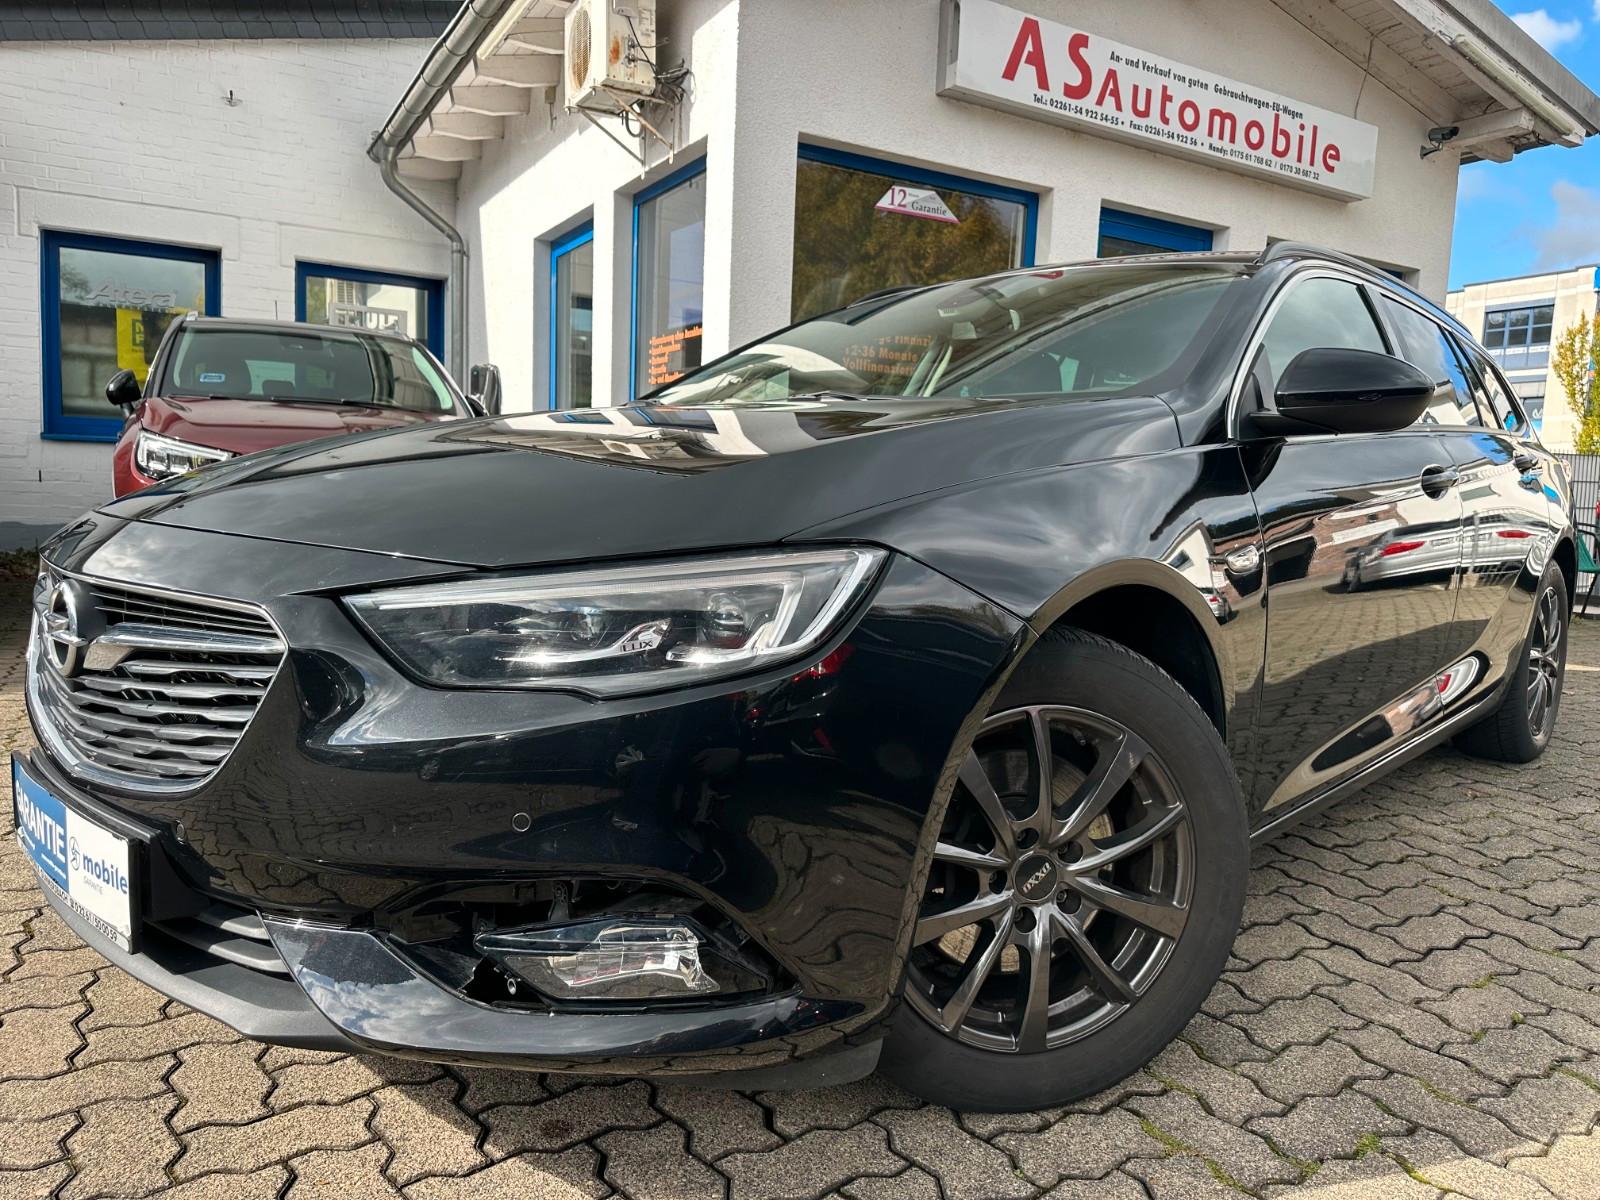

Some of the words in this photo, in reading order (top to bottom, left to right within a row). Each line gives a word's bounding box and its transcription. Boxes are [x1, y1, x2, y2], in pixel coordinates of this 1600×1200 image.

[1109, 50, 1123, 63] An-
[1125, 57, 1140, 69] und
[1142, 60, 1172, 79] Verkauf
[1173, 72, 1187, 84] von
[1187, 78, 1209, 91] guten
[1049, 98, 1083, 115] 02261-54
[1085, 108, 1099, 120] 922
[1100, 112, 1119, 126] 54-55
[1129, 120, 1143, 131] Fax:
[1144, 124, 1175, 140] 02261-54
[1176, 133, 1189, 144] 922
[1189, 137, 1198, 147] 56
[1208, 142, 1229, 157] Handy:
[1229, 148, 1245, 160] 0175
[1244, 153, 1253, 163] 61
[1264, 159, 1273, 168] 62
[888, 187, 907, 208] 12
[911, 201, 947, 216] Garantie
[16, 779, 66, 864] GARANTIE
[83, 852, 128, 895] mobile
